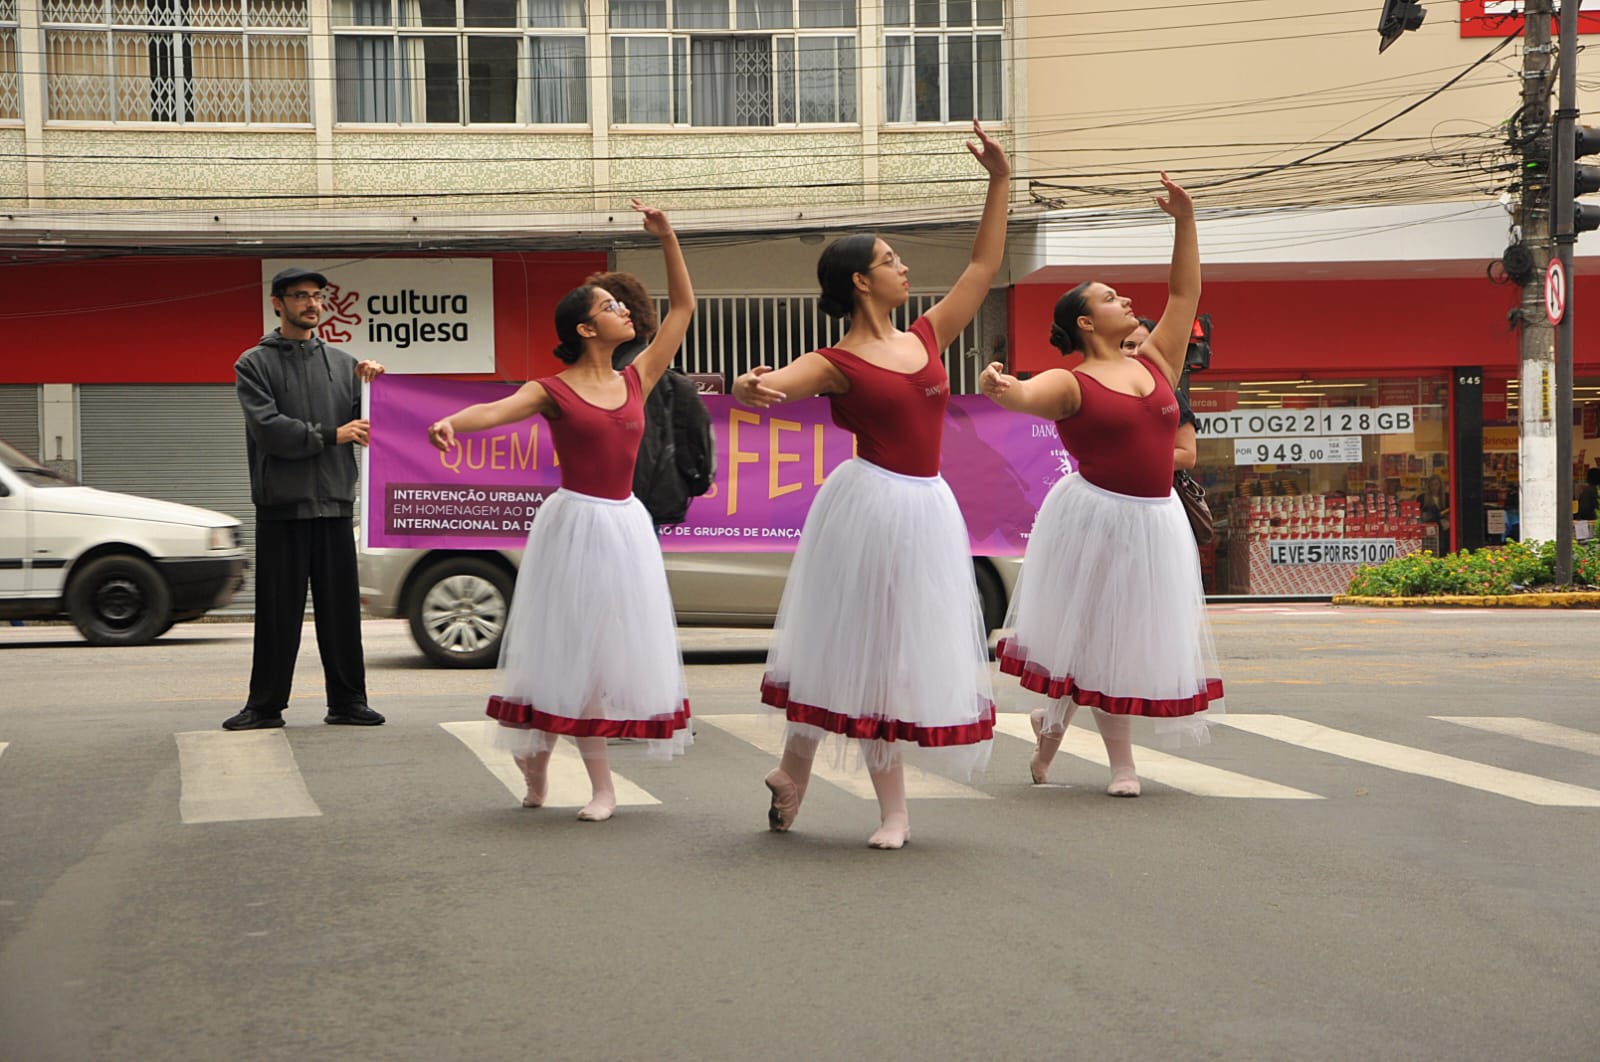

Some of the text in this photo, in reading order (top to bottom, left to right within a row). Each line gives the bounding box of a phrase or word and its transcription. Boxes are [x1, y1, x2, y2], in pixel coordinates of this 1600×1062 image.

[367, 290, 467, 314] cultura
[368, 318, 468, 348] inglesa
[439, 423, 538, 474] QUEM
[393, 489, 544, 503] INTERVENÇÃO URBANA
[393, 504, 412, 514] EM
[416, 504, 500, 516] HOMENAGEM
[503, 506, 522, 516] AO
[393, 518, 498, 530] INTERNACIONAL
[502, 520, 521, 530] DA
[675, 527, 691, 536] DE
[694, 527, 740, 536] GRUPOS
[743, 528, 758, 537] DE
[762, 528, 802, 538] DANÇA
[1307, 545, 1322, 562] 5
[1324, 545, 1340, 562] POR
